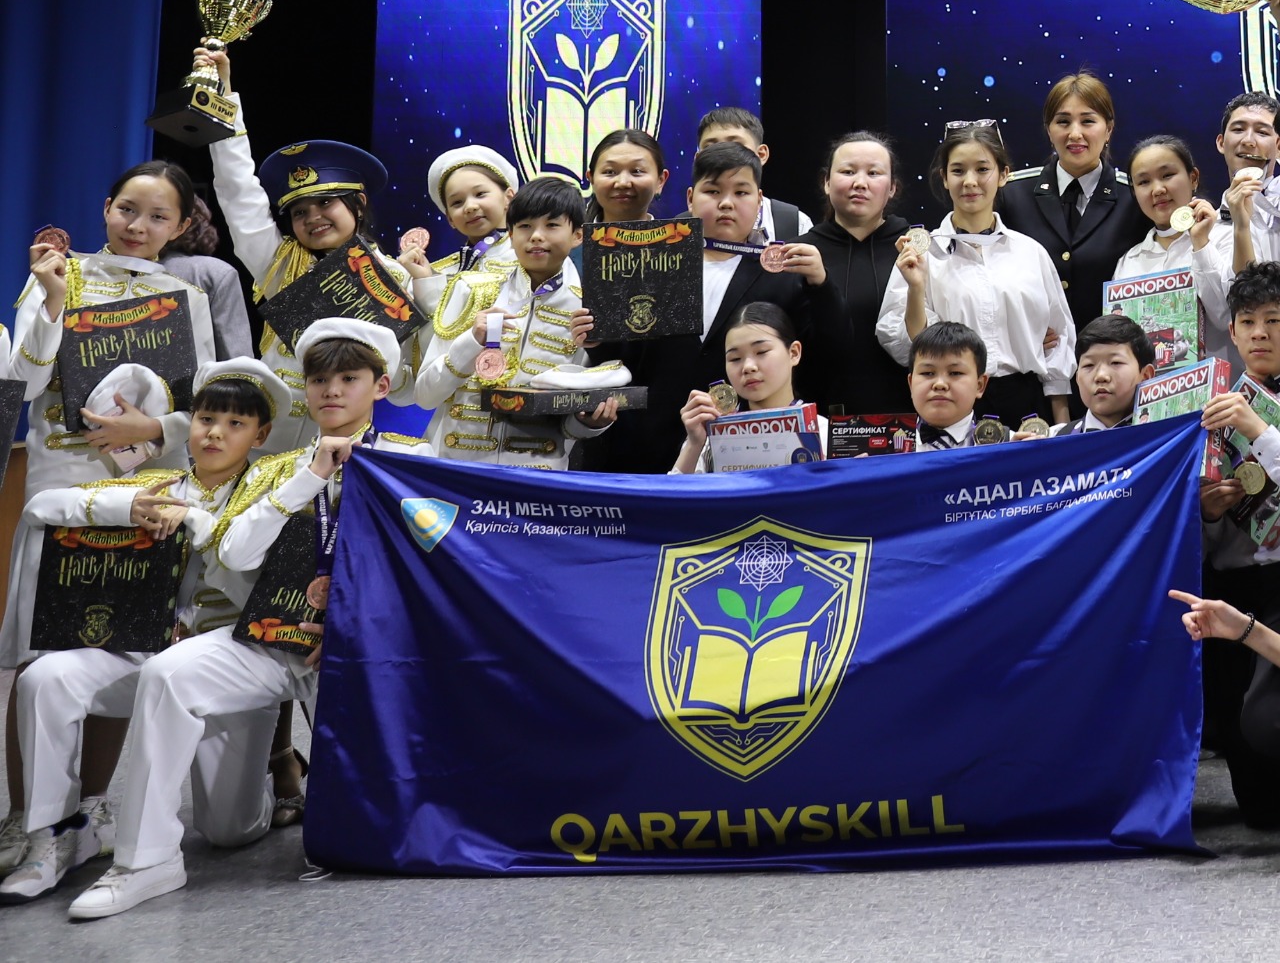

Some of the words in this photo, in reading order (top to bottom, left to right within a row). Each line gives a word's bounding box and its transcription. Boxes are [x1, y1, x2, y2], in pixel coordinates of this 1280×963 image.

[601, 252, 640, 282] Harry
[639, 248, 683, 281] Potter
[319, 269, 358, 306] Harry
[1109, 272, 1194, 301] MONOPOLY
[79, 334, 124, 368] Harry
[122, 327, 173, 361] Potter
[1138, 367, 1210, 404] MONOPOLY
[832, 426, 886, 435] СЕРТИФИКАТ
[944, 481, 1023, 507] «АДАЛ
[1029, 467, 1133, 497] АЗАМАТ»
[945, 509, 997, 523] БІРТҰТАС
[1000, 503, 1043, 518] ТӘРБИЕ
[1045, 487, 1133, 512] БАҒДАРЛАМАСЫ
[471, 499, 511, 519] ЗАҢ
[515, 502, 554, 517] МЕН
[557, 504, 623, 519] ТӘРТІП
[465, 520, 519, 535] Қауіпсіз
[522, 522, 590, 537] Қазақстан
[594, 523, 627, 538] үшін!
[58, 554, 103, 587] Harry
[101, 551, 150, 589] Potter
[550, 794, 965, 863] QARZHYSKILL
